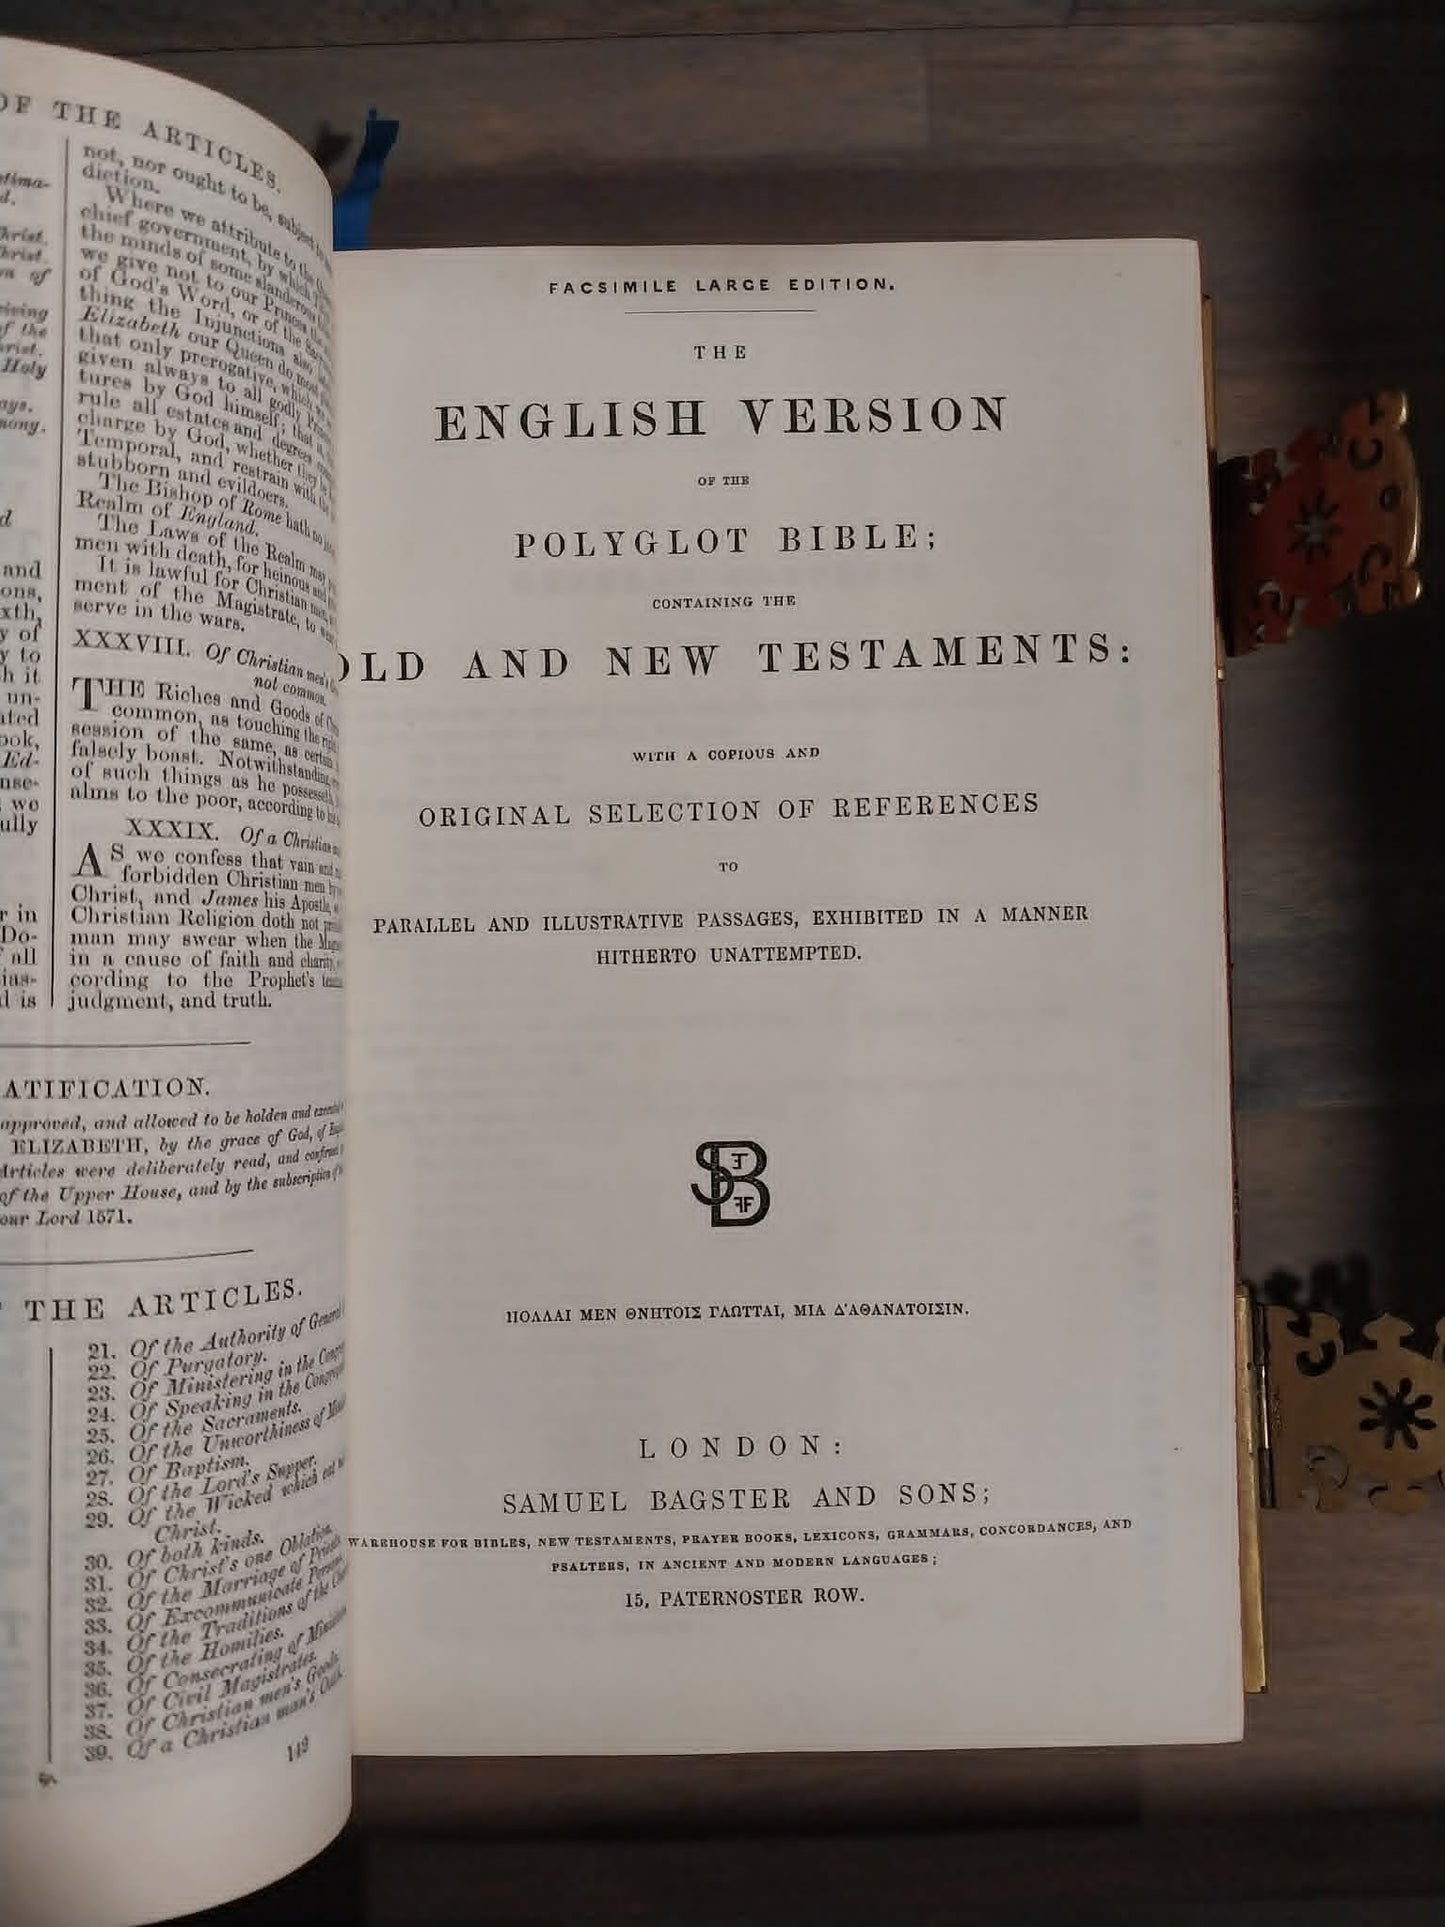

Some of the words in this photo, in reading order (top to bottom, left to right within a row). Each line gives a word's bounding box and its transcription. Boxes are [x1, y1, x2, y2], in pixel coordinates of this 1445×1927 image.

[53, 101, 120, 129] THE
[144, 121, 281, 194] ARTICLES.
[83, 145, 124, 167] not,
[132, 155, 166, 174] nor
[173, 166, 225, 197] ought
[549, 279, 677, 295] FACSIMILE
[695, 278, 771, 293] LARGE
[789, 277, 895, 292] EDITION.
[693, 344, 746, 360] THE
[433, 399, 707, 442] ENGLISH
[738, 396, 1008, 436] VERSION
[697, 476, 716, 487] OF
[722, 475, 750, 486] THE
[77, 490, 143, 515] Realm
[152, 502, 173, 519] of
[179, 504, 258, 538] England.
[98, 513, 139, 535] The
[150, 518, 199, 542] Laws
[208, 531, 227, 549] of
[234, 534, 258, 556] the
[265, 543, 306, 572] Realm
[513, 527, 748, 559] POLYGLOT
[778, 523, 935, 553] BIBLE;
[73, 599, 127, 616] serve
[135, 600, 152, 618] in
[161, 603, 192, 623] the
[200, 612, 245, 632] wars.
[74, 579, 128, 595] ment
[140, 580, 159, 598] of
[174, 584, 204, 604] the
[217, 590, 299, 628] Magistrate,
[652, 596, 754, 610] CONTAINING
[762, 594, 796, 607] THE
[72, 629, 190, 657] XXXVIII.
[205, 643, 231, 664] Of
[237, 648, 303, 678] Christian
[461, 648, 568, 680] AND
[605, 644, 721, 677] NEW
[758, 632, 1130, 673] TESTAMENTS:
[156, 681, 220, 706] Riches
[231, 692, 260, 712] and
[270, 698, 310, 722] Goods
[632, 750, 677, 763] WITH
[686, 750, 698, 762] A
[707, 747, 775, 761] COPIOUS
[784, 746, 820, 759] AND
[70, 782, 118, 800] alms
[128, 786, 147, 801] to
[156, 786, 189, 805] the
[196, 793, 243, 812] poor,
[248, 799, 313, 821] according
[418, 804, 571, 828] ORIGINAL
[588, 799, 761, 825] SELECTION
[778, 799, 815, 820] OF
[831, 792, 1039, 818] REFERENCES
[124, 818, 219, 841] XXXIX.
[240, 826, 264, 846] Of
[267, 834, 277, 845] a
[137, 850, 165, 864] we
[175, 848, 242, 867] confess
[252, 851, 282, 870] that
[718, 861, 739, 873] TO
[120, 865, 218, 886] forbidden
[226, 870, 298, 891] Christian
[71, 905, 170, 926] Christian
[177, 909, 255, 930] Religion
[262, 911, 295, 930] doth
[372, 916, 476, 935] PARALLEL
[487, 915, 530, 933] AND
[541, 913, 684, 932] ILLUSTRATIVE
[696, 910, 799, 930] PASSAGES,
[812, 908, 924, 926] EXHIBITED
[936, 907, 961, 924] IN
[973, 907, 987, 923] A
[1001, 905, 1089, 923] MANNER
[70, 932, 114, 947] man
[128, 933, 171, 953] may
[182, 934, 237, 948] swear
[246, 930, 288, 949] when
[294, 931, 314, 950] the
[595, 947, 697, 966] HITHERTO
[709, 944, 862, 964] UNATTEMPTED.
[69, 950, 90, 967] in
[102, 955, 114, 967] a
[125, 952, 181, 967] cause
[191, 951, 212, 967] of
[220, 951, 260, 968] faith
[268, 951, 294, 969] and
[70, 970, 150, 991] cording
[167, 970, 187, 988] to
[204, 970, 233, 988] the
[247, 970, 314, 991] Prophet's
[68, 992, 174, 1013] judgment,
[180, 991, 216, 1009] and
[223, 990, 272, 1009] truth.
[94, 1112, 127, 1130] and
[133, 1110, 197, 1129] allowed
[204, 1113, 218, 1126] to
[224, 1110, 240, 1125] be
[245, 1103, 287, 1124] holden
[12, 1137, 148, 1155] ELIZABETH,
[159, 1137, 178, 1153] by
[188, 1136, 211, 1150] the
[219, 1134, 260, 1152] grace
[267, 1129, 282, 1146] of
[36, 1208, 80, 1226] Lord
[25, 1297, 104, 1322] THE
[127, 1277, 302, 1318] ARTICLES.
[130, 1339, 159, 1361] Of
[164, 1335, 193, 1352] the
[199, 1324, 286, 1351] Authority
[129, 1422, 159, 1445] Of
[163, 1422, 193, 1436] the
[202, 1400, 301, 1432] Sacraments.
[639, 1434, 841, 1459] LONDON:
[128, 1463, 157, 1487] Of
[166, 1454, 250, 1480] Baptism.
[128, 1484, 157, 1506] Of
[162, 1482, 192, 1498] the
[200, 1468, 259, 1495] Lord's
[266, 1454, 317, 1481] Supper.
[503, 1490, 628, 1515] SAMUEL
[650, 1487, 791, 1512] BAGSTER
[811, 1485, 876, 1508] AND
[899, 1482, 989, 1506] SONS;
[347, 1537, 436, 1549] WAREHOUSE
[440, 1538, 469, 1549] FOR
[473, 1537, 531, 1551] BIBLES,
[537, 1536, 571, 1548] NEW
[574, 1534, 677, 1547] TESTAMENTS,
[681, 1533, 740, 1544] PRAYER
[744, 1532, 798, 1544] BOOKS,
[802, 1530, 880, 1543] LEXICONS,
[887, 1527, 975, 1541] GRAMMARS,
[979, 1520, 1097, 1537] CONCORDANCES,
[1102, 1518, 1132, 1529] AND
[551, 1560, 630, 1573] PSALTERS,
[638, 1560, 655, 1571] IN
[661, 1559, 728, 1570] ANCIENT
[733, 1558, 765, 1569] AND
[772, 1556, 835, 1569] MODERN
[842, 1553, 937, 1567] LANGUAGES;
[624, 1591, 650, 1610] 15,
[659, 1588, 804, 1608] PATERNOSTER
[812, 1586, 865, 1604] ROW.
